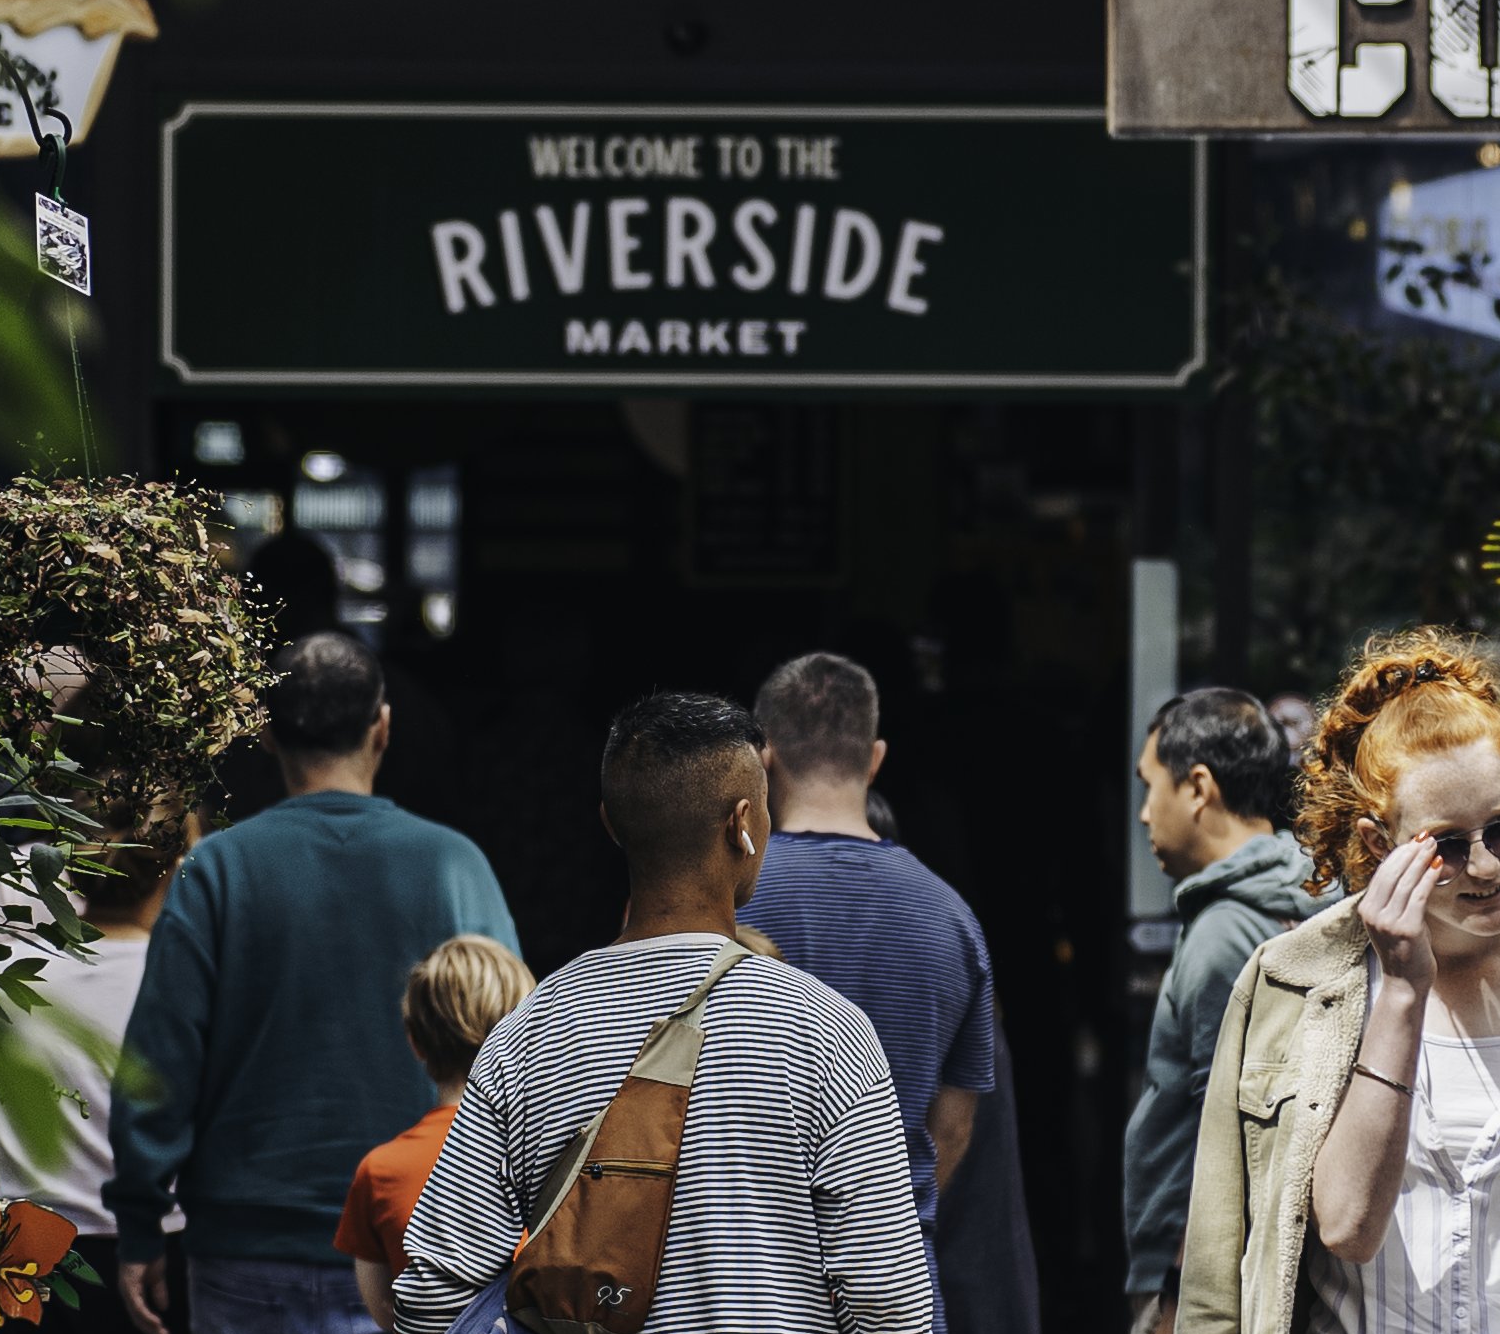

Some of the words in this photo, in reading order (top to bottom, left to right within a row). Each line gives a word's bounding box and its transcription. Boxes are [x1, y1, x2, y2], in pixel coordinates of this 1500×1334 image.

[527, 134, 702, 180] WELCOME
[717, 135, 764, 178] TO
[777, 135, 842, 180] THE
[431, 195, 946, 316] RIVERSIDE
[563, 318, 808, 356] MARKET
